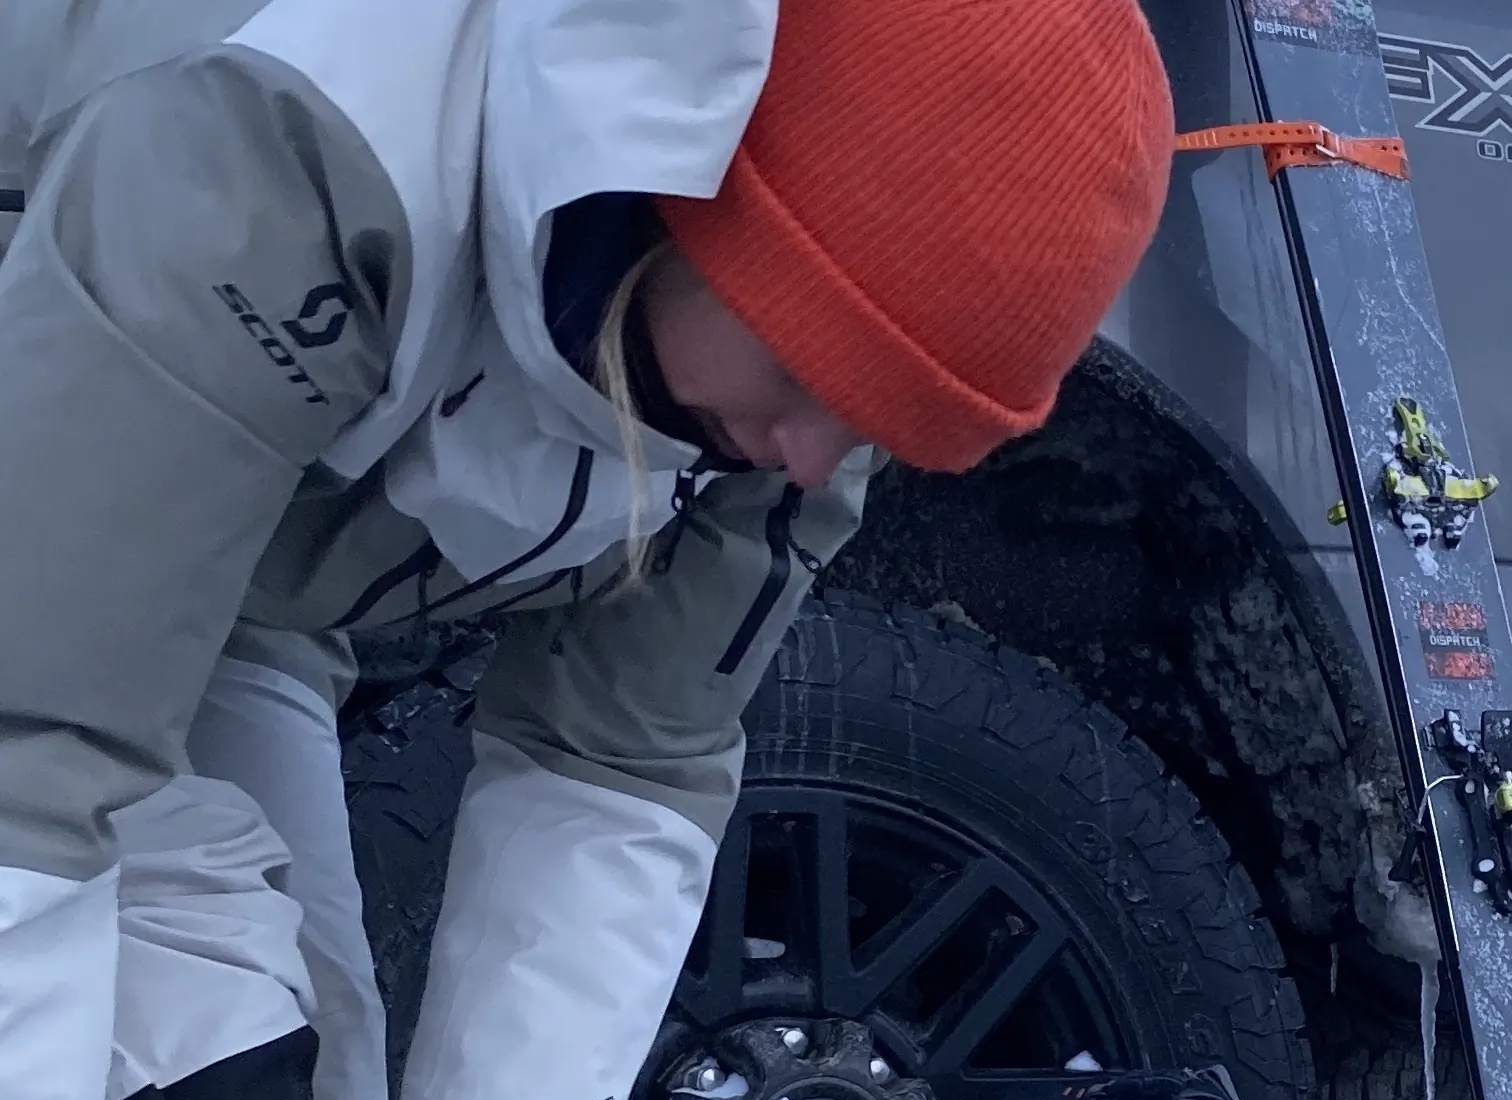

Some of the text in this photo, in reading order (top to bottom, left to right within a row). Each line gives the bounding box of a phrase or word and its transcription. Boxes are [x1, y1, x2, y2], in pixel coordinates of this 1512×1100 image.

[1253, 18, 1318, 42] DISPATCH
[212, 283, 330, 406] SCOTT
[1429, 634, 1481, 647] DISPATCH
